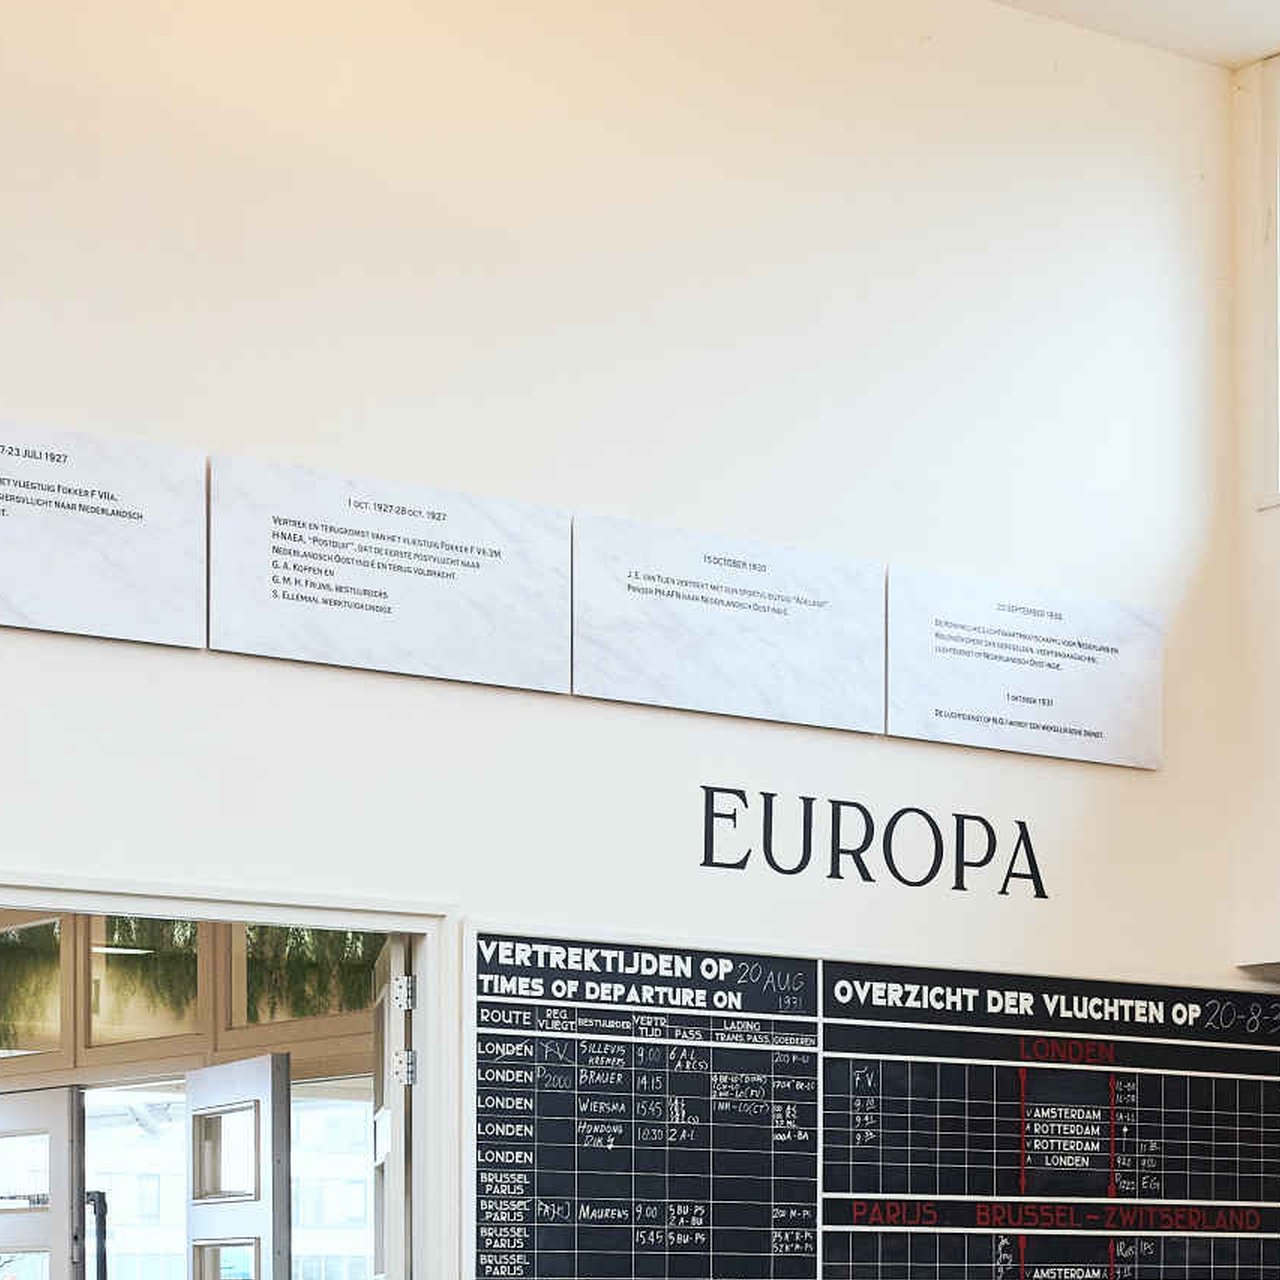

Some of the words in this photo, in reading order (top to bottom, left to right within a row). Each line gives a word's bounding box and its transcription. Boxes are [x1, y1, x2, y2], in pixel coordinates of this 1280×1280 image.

[699, 785, 1049, 898] EUROPA
[477, 939, 692, 978] VERTREKTIJDEN
[699, 957, 734, 981] OP
[736, 962, 762, 984] 20
[763, 970, 805, 993] AUG
[478, 973, 545, 997] TIMES
[550, 978, 579, 999] OF
[584, 980, 707, 1008] DEPARTURE
[712, 990, 742, 1010] ON
[833, 979, 979, 1012] OVERZICHT
[986, 988, 1034, 1016] DER
[1041, 993, 1165, 1024] VLUCHTEN
[1172, 1002, 1202, 1026] OP
[480, 1008, 531, 1026] ROUTE
[1020, 1037, 1115, 1063] LONDEN
[477, 1070, 534, 1084] LONDEN
[1033, 1108, 1102, 1121] AMSTERDAM
[477, 1124, 534, 1137] LONDEN
[1034, 1123, 1100, 1136] ROTTERDAM
[480, 1173, 530, 1184] BRUSSEL
